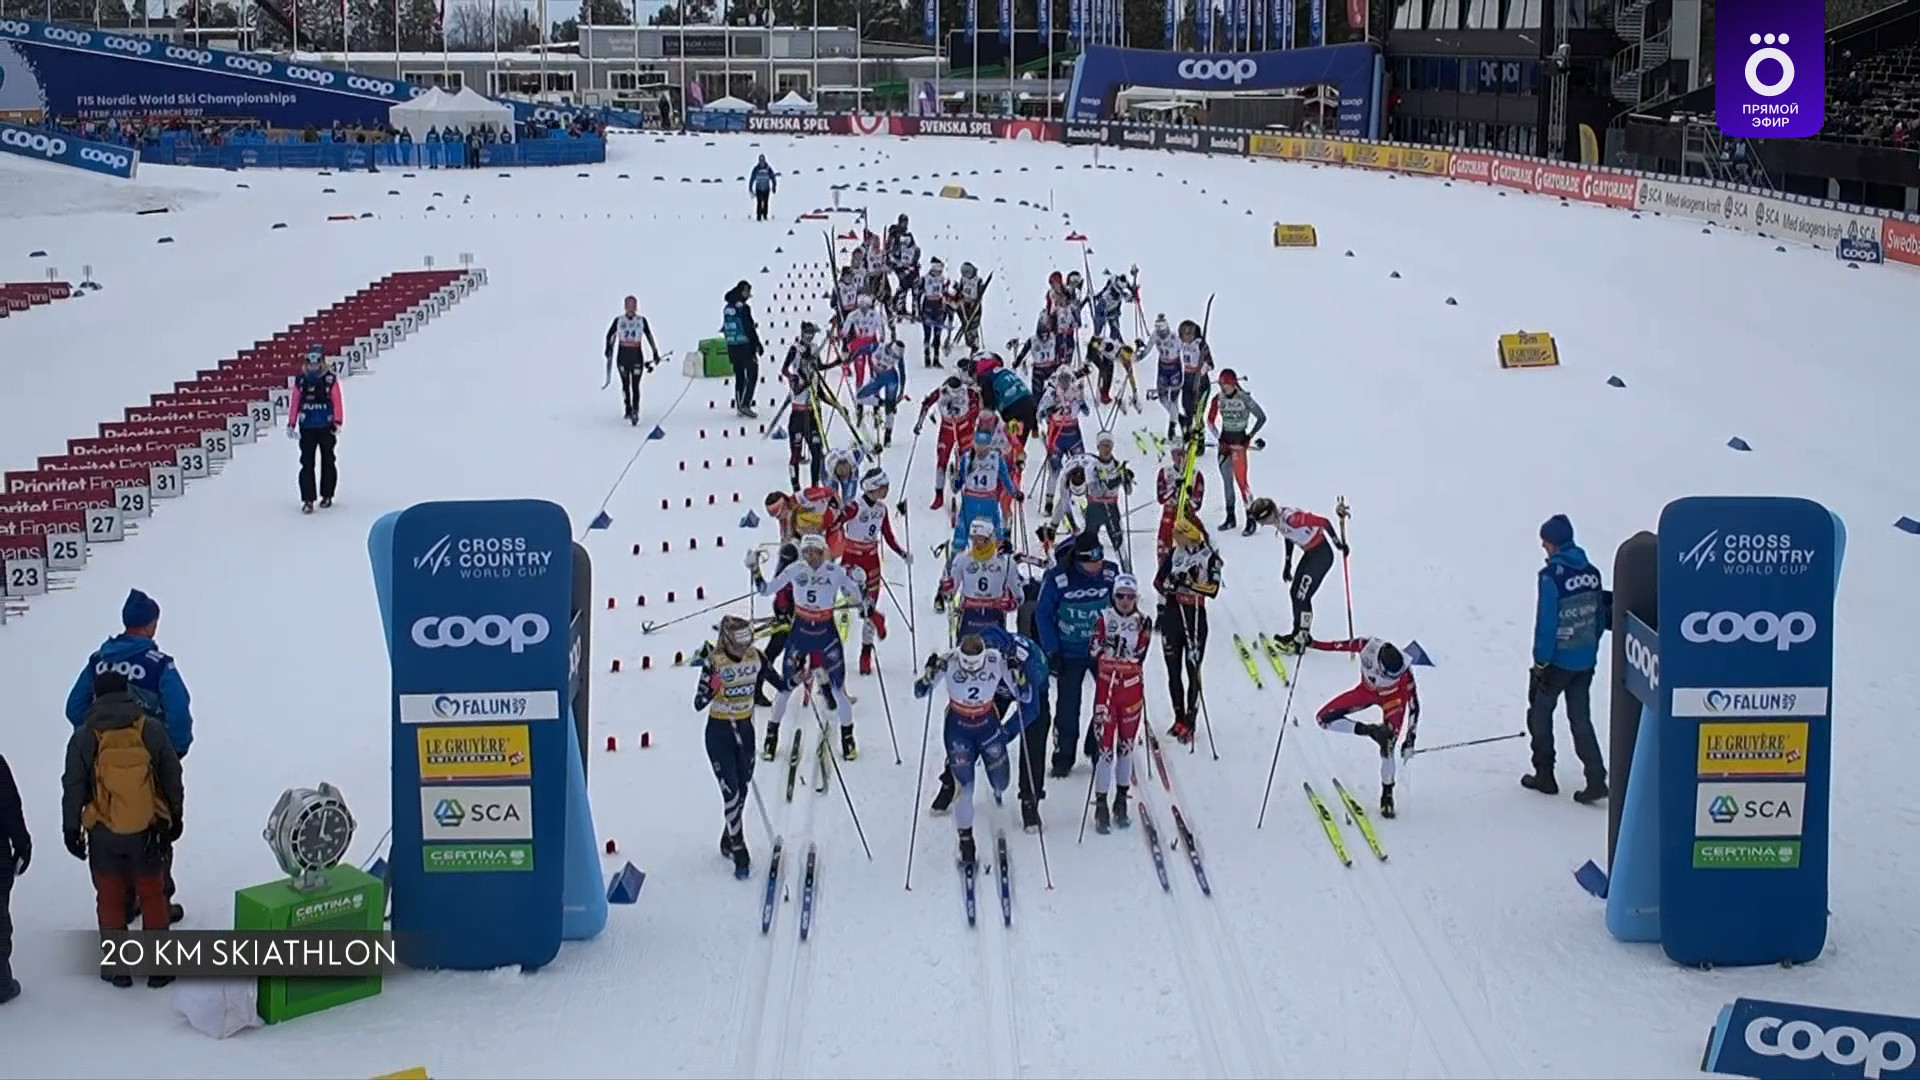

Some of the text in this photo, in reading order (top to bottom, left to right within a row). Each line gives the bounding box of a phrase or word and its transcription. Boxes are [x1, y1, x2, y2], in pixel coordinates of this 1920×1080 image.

[44, 27, 91, 45] coop
[104, 36, 151, 54] coop
[165, 46, 213, 65] coop
[225, 55, 272, 75] coop
[1178, 58, 1257, 84] coop
[286, 65, 334, 86] coop
[347, 75, 395, 96] coop
[77, 91, 297, 107] FIS Nordic World Ski Championships
[749, 117, 830, 131] SVENSKA SPEL
[919, 120, 992, 135] SVENSKA SPEL
[2, 128, 66, 157] coop
[80, 148, 128, 168] coop
[1500, 165, 1533, 184] GATORADE
[1543, 172, 1580, 193] GATORADE
[1592, 179, 1635, 200] GATORADE
[1649, 188, 1662, 202] SCA
[1733, 201, 1748, 217] SCA
[1765, 208, 1779, 225] SCA
[1783, 213, 1797, 231] Med
[1798, 218, 1826, 239] skogens
[1843, 248, 1877, 261] coop
[275, 395, 289, 408] 41
[252, 408, 271, 421] 39
[232, 423, 250, 437] 37
[205, 438, 226, 453] 35
[181, 456, 203, 470] 33
[11, 476, 146, 494] Prioritet Finans
[157, 474, 176, 490] 31
[973, 474, 987, 486] 14
[121, 494, 144, 511] 29
[20, 520, 80, 536] Finans
[92, 516, 114, 533] 27
[868, 524, 877, 537] 9
[458, 537, 526, 553] CROSS
[1724, 534, 1791, 548] CROSS
[53, 541, 78, 559] 25
[1724, 550, 1815, 564] COUNTRY
[459, 551, 552, 568] COUNTRY
[12, 568, 39, 587] 23
[460, 566, 547, 579] WORLD CUP
[1723, 564, 1808, 575] WORLD CUP
[978, 577, 989, 592] 6
[1565, 574, 1599, 591] coop
[806, 590, 817, 603] 5
[411, 612, 550, 653] coop
[1680, 611, 1816, 651] coop
[969, 671, 996, 681] SCA
[725, 684, 756, 695] coop
[967, 687, 980, 700] 2
[463, 699, 511, 715] FALUN
[1733, 693, 1781, 710] FALUN
[426, 735, 507, 754] LE GRUYÈRE
[1707, 732, 1785, 750] LE GRUYÈRE
[471, 804, 520, 822] SCA
[1744, 800, 1792, 818] SCA
[430, 850, 507, 860] CERTINA
[1701, 846, 1776, 856] CERTINA
[296, 896, 351, 918] CERTINA
[1744, 1016, 1917, 1079] coop
